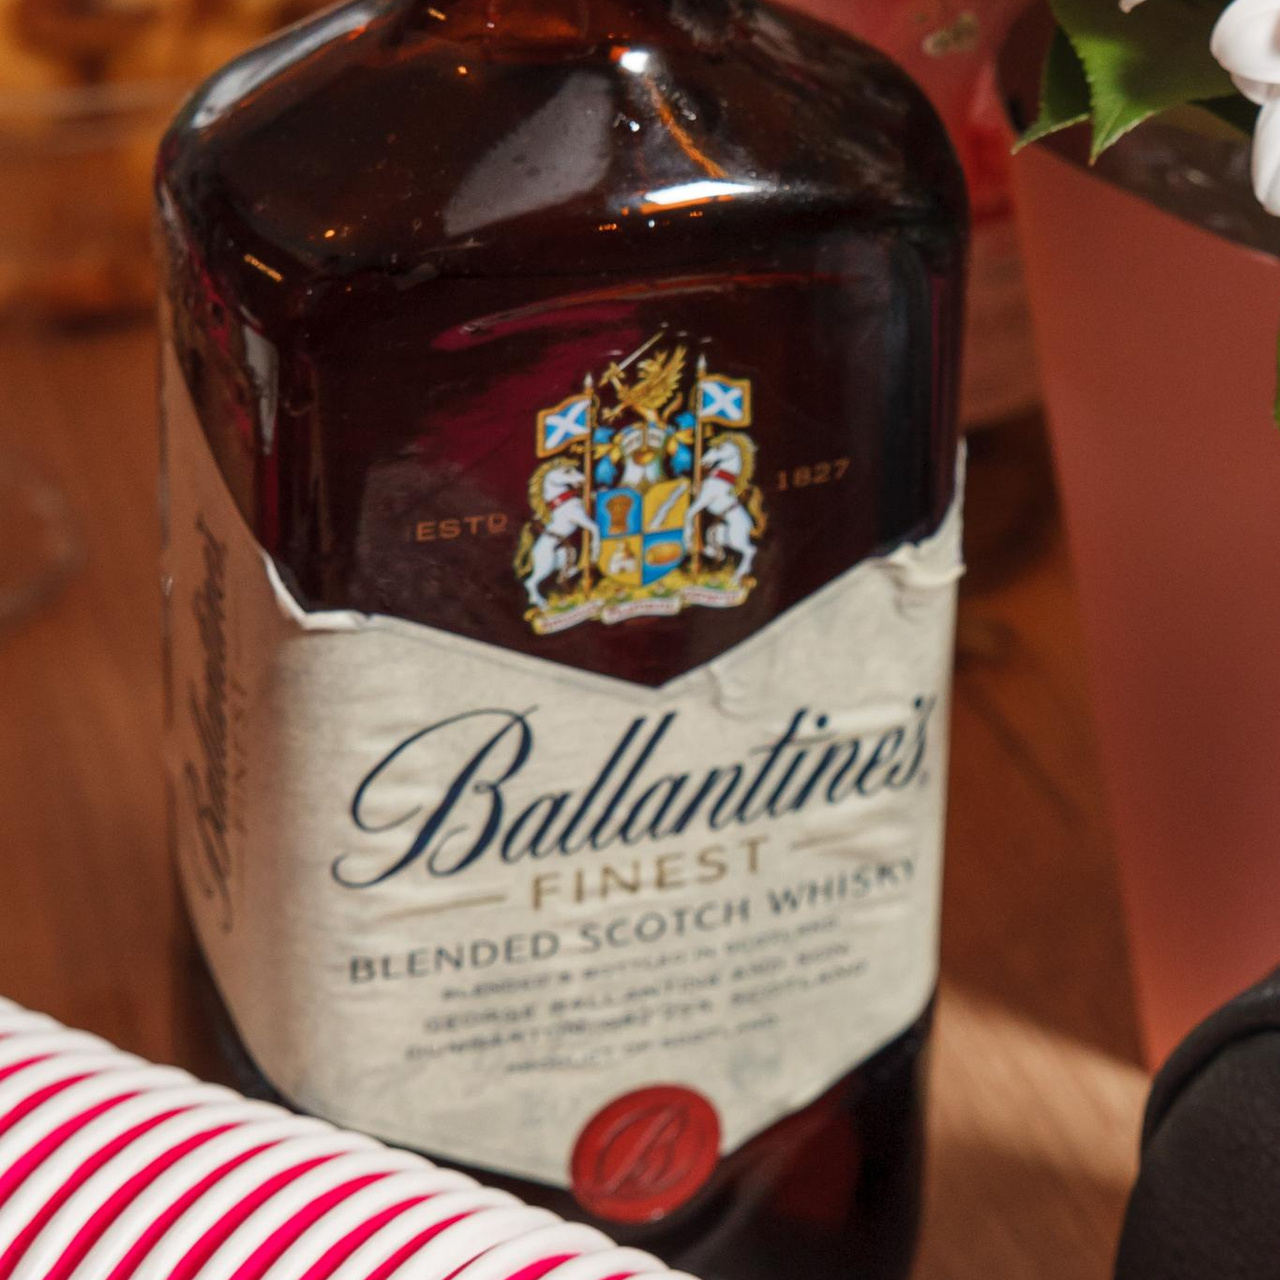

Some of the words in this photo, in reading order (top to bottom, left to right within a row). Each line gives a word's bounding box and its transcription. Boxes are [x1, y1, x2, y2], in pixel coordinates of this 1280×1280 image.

[775, 458, 851, 492] 1827
[415, 512, 508, 542] ESTD
[331, 694, 937, 889] Ballantine's
[531, 834, 770, 911] FINEST
[349, 929, 560, 985] BLENDED
[579, 896, 751, 953] SCOTCH
[767, 857, 916, 915] WHISKY
